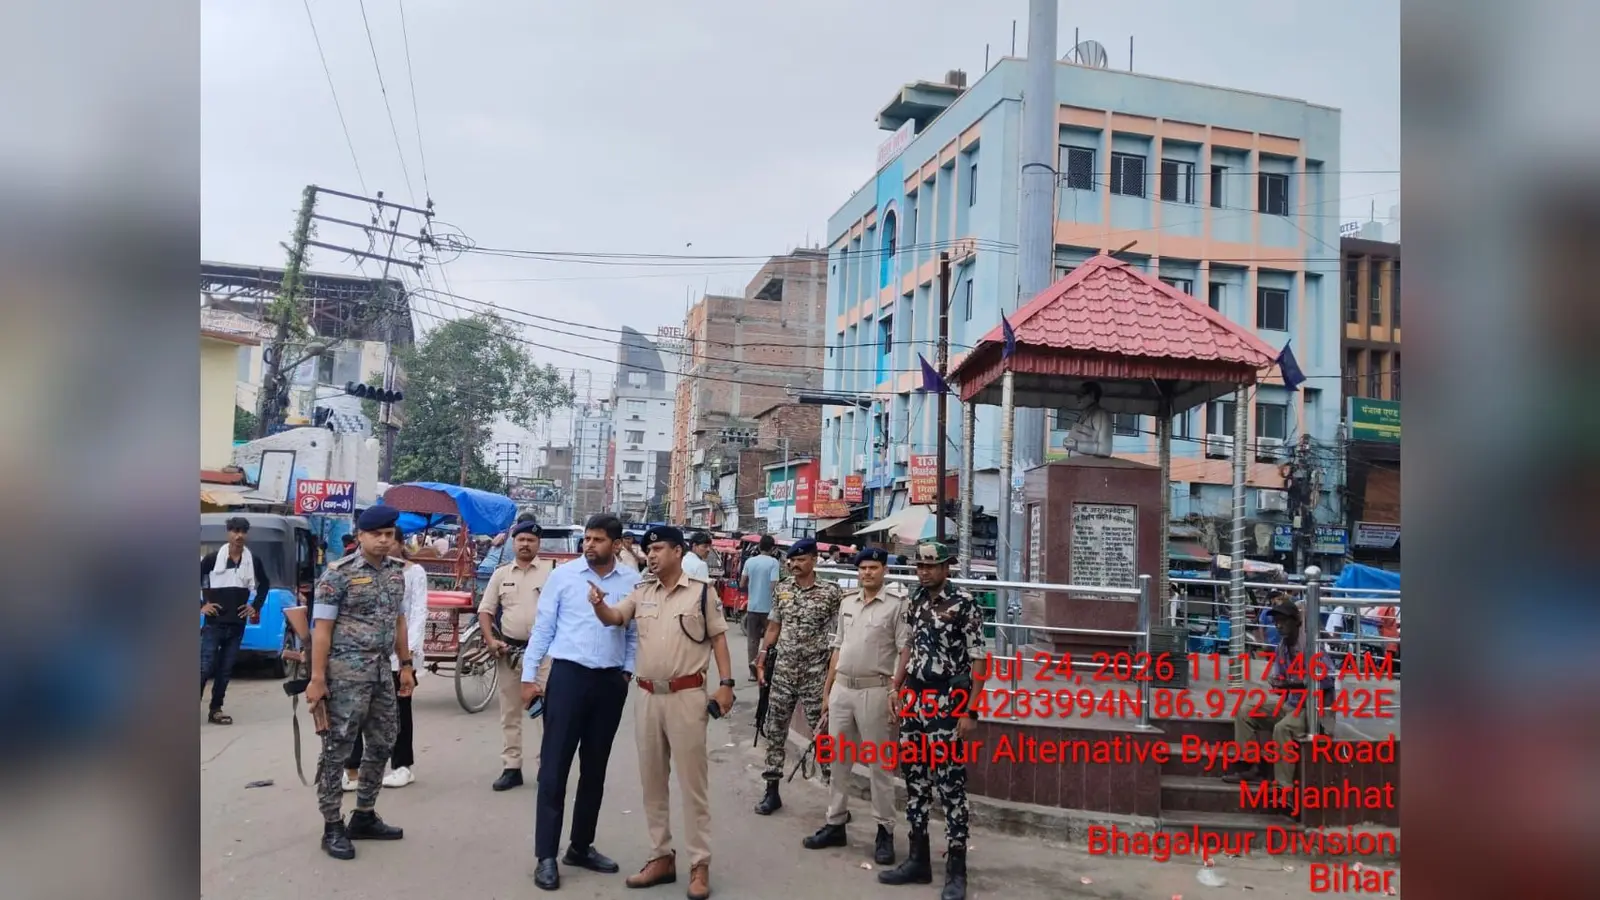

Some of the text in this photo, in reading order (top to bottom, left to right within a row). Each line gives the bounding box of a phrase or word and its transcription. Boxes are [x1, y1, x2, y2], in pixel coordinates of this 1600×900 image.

[1340, 221, 1360, 233] OTEL
[657, 325, 685, 337] HOTEL
[299, 482, 352, 496] ONE WAY
